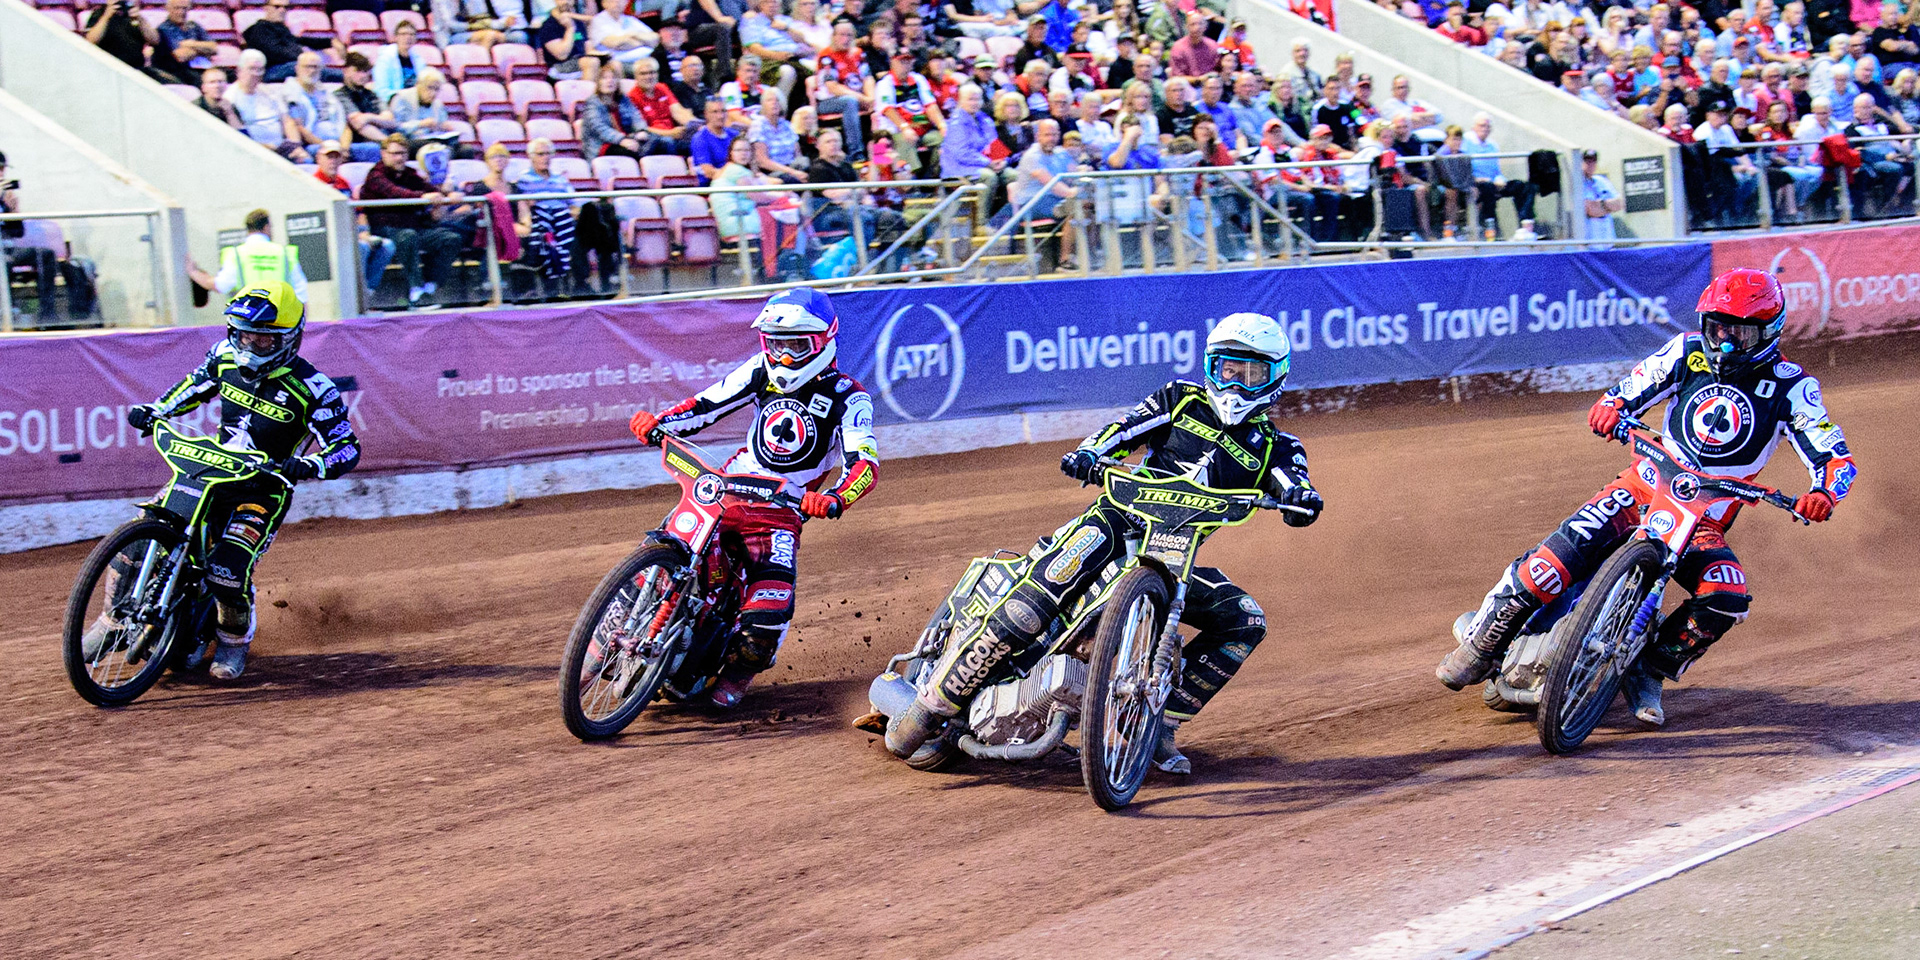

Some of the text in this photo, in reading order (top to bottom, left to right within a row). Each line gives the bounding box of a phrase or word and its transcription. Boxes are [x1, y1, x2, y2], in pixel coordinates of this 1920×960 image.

[1321, 305, 1409, 349] Class
[1417, 294, 1519, 342] Travel
[1528, 288, 1671, 333] Solutions
[891, 343, 948, 381] ATPI
[1006, 321, 1196, 374] Delivering
[437, 373, 492, 399] Proud
[496, 374, 517, 394] to
[521, 371, 592, 395] sponsor
[595, 364, 625, 386] the
[628, 362, 671, 384] Belle
[672, 360, 704, 381] Vue
[223, 386, 253, 405] TRU
[255, 402, 289, 421] MIX
[481, 403, 589, 431] Premiership
[592, 398, 647, 422] Junior
[763, 401, 787, 418] BELLE
[803, 412, 815, 437] ACES
[1693, 387, 1719, 405] BELLE
[1737, 401, 1750, 425] ACES
[172, 444, 235, 469] TRU MIX
[1184, 420, 1255, 466] TRU MIX
[1143, 490, 1224, 511] TRU MIX
[1568, 488, 1635, 541] Nice
[1151, 532, 1190, 545] HAGON
[1653, 517, 1670, 529] ATPI
[1050, 532, 1096, 577] AGROMIX
[1148, 540, 1188, 551] SHOCKS
[1703, 564, 1746, 585] GM
[1007, 602, 1039, 631] ORTEMA
[944, 626, 1000, 696] HAGON
[960, 641, 1012, 697] SHOCKS
